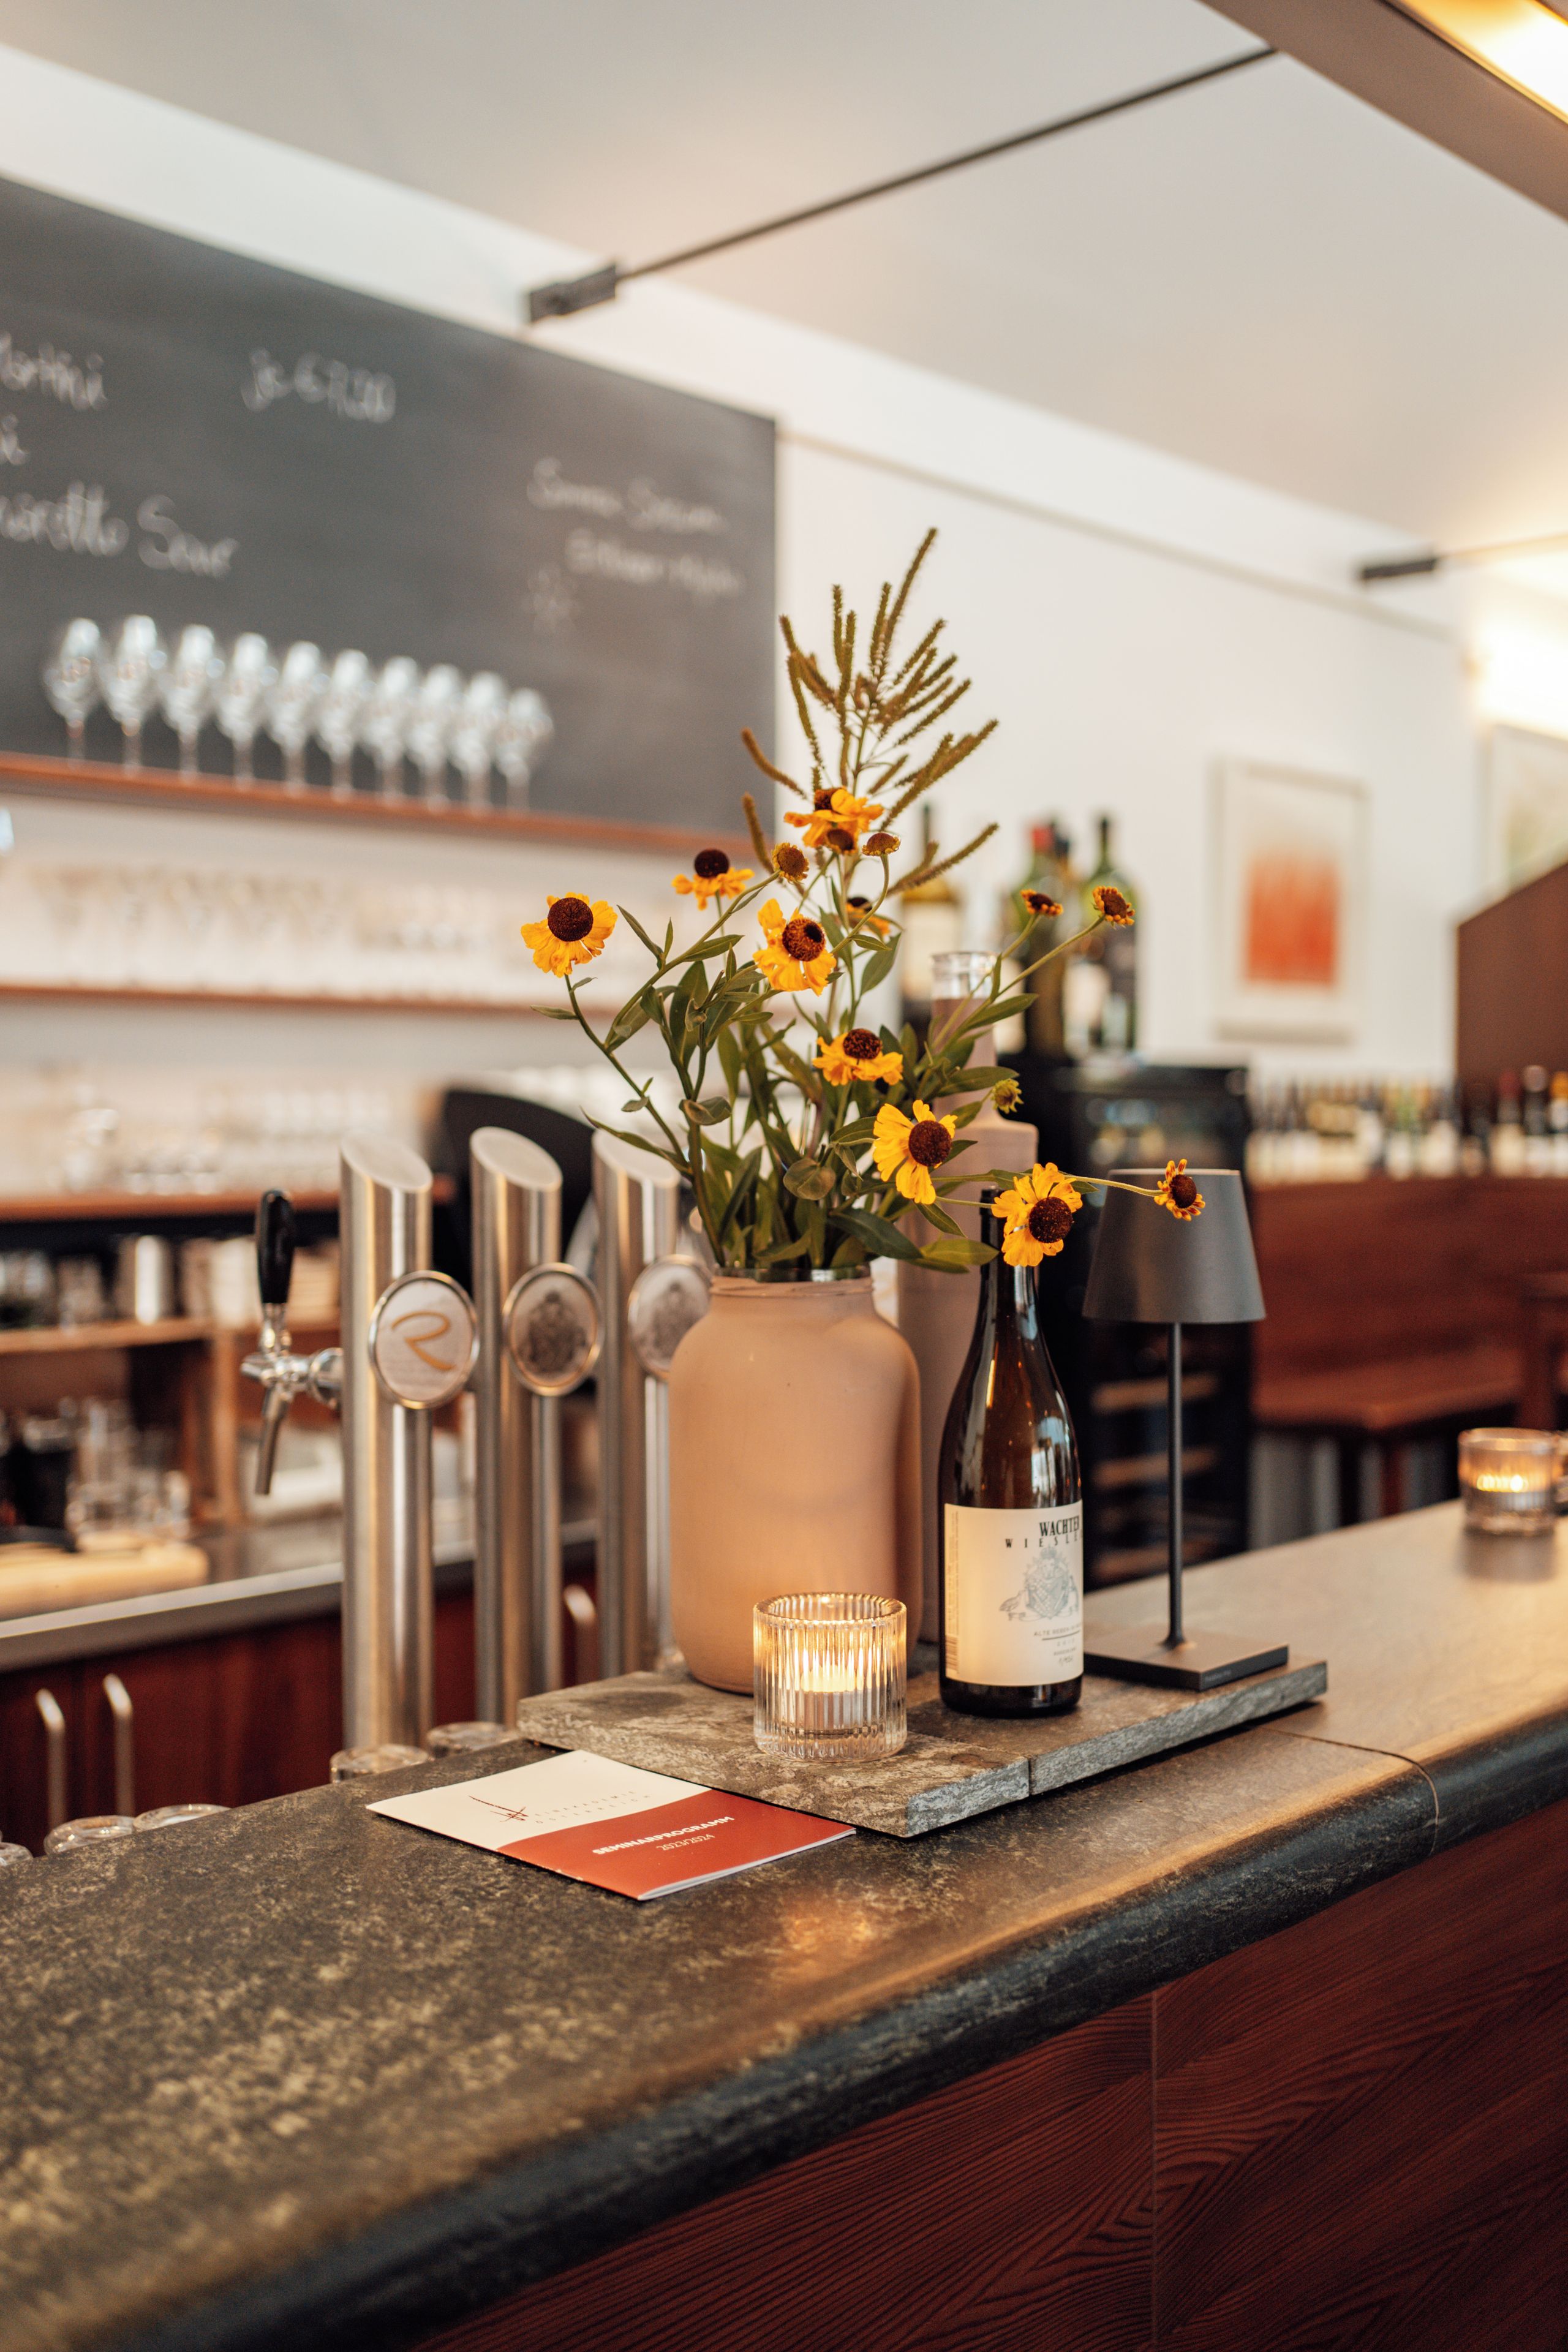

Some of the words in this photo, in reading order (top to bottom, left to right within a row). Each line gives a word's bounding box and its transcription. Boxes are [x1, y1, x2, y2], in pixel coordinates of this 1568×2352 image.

[1005, 1531, 1082, 1548] WIESLE
[592, 1815, 736, 1855] SEMINARPROGRAMM
[656, 1833, 715, 1851] 2023/2024
